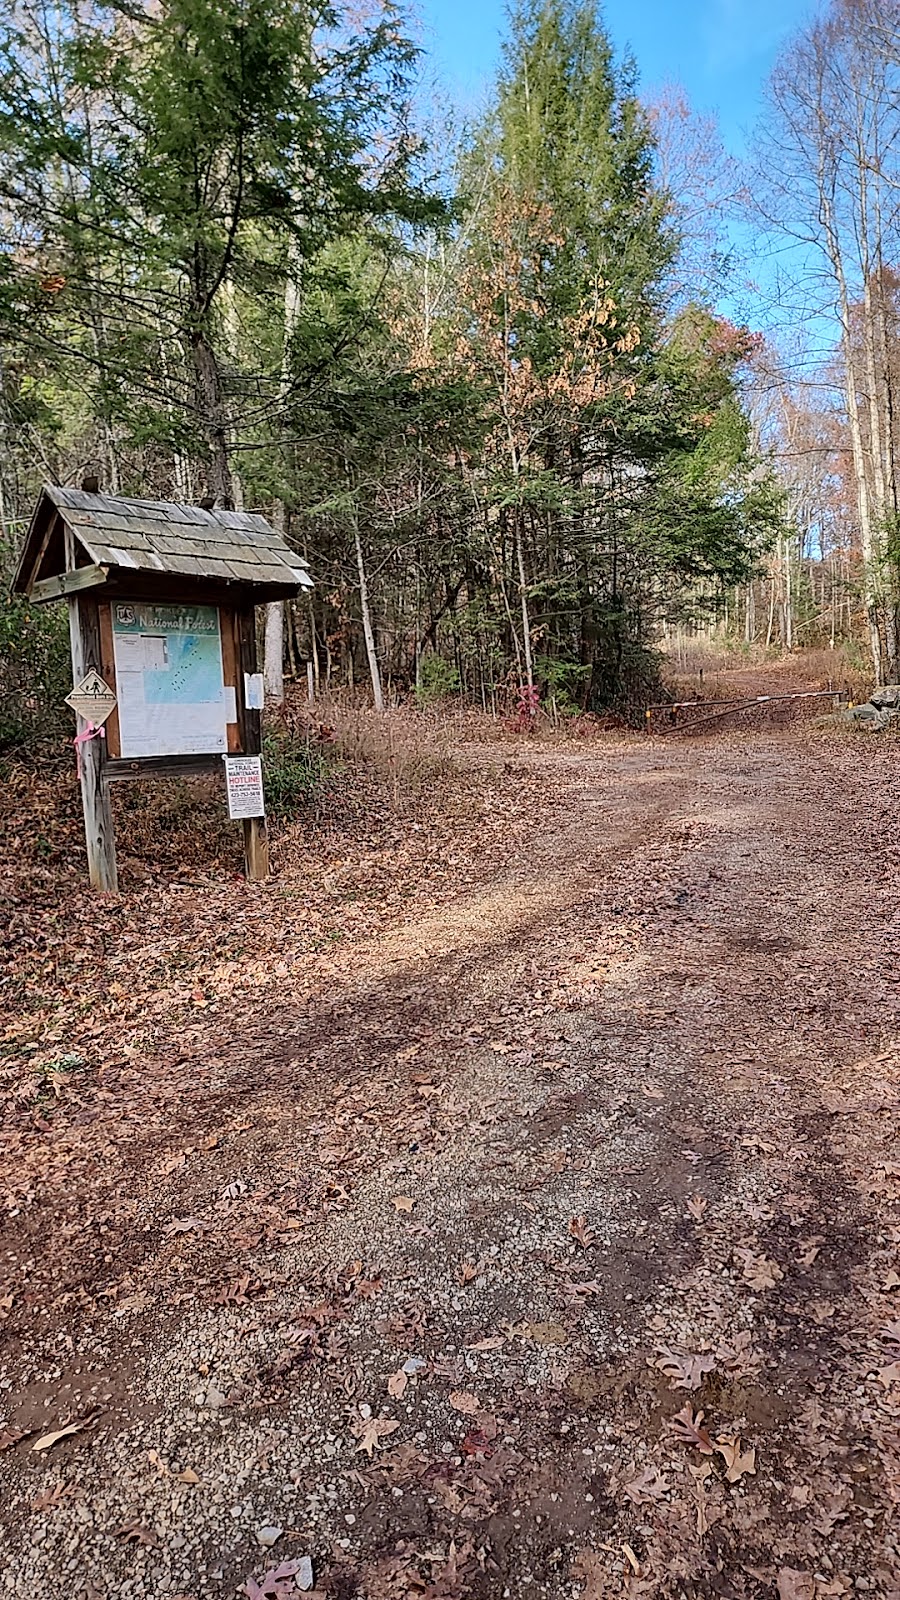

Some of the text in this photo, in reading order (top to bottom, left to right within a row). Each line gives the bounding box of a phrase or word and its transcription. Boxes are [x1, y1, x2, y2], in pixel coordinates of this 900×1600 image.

[139, 615, 215, 630] National Forest
[229, 776, 260, 785] HOTLINE
